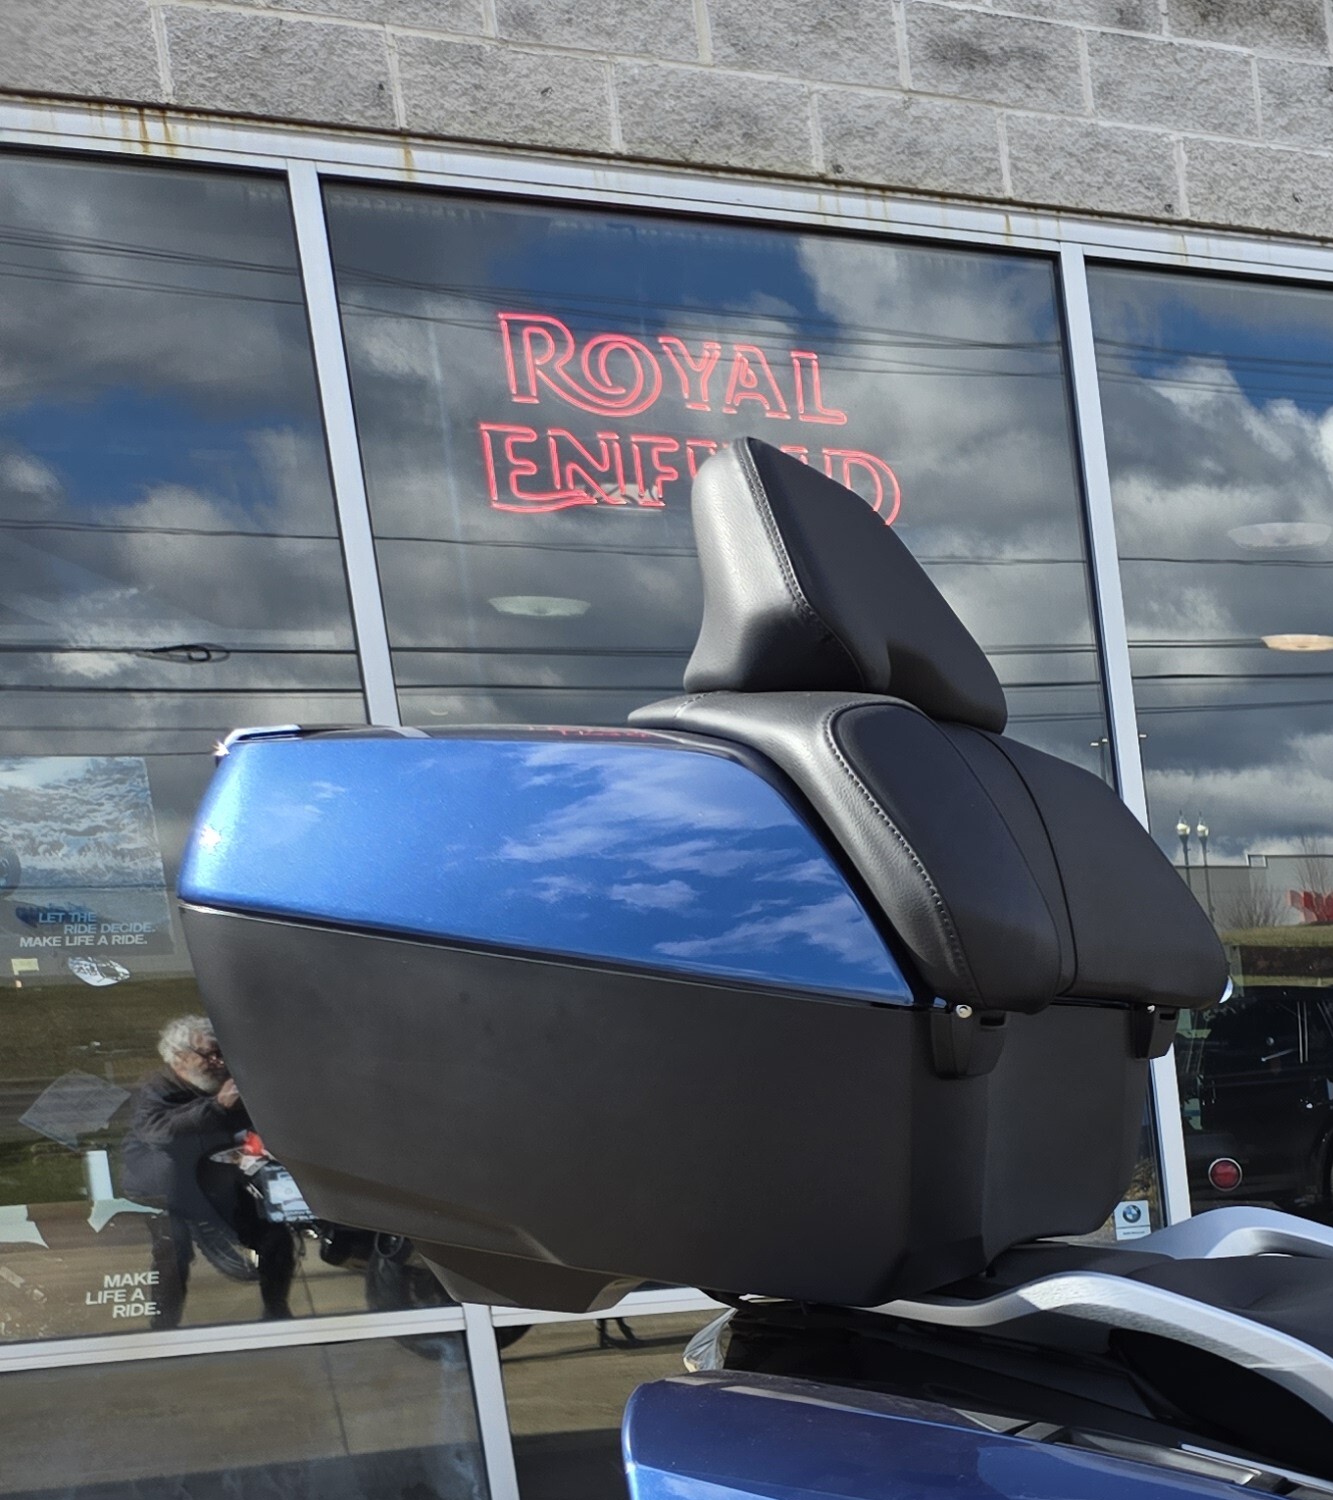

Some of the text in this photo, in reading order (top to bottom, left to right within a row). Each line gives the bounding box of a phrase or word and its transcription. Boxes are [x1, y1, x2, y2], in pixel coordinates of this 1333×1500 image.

[498, 312, 848, 426] ROYAL
[38, 911, 97, 924] LET THE
[63, 922, 156, 935] RIDE DECIDE.
[19, 933, 148, 948] MAKE LIFE A RIDE.
[103, 1270, 160, 1288] MAKE
[85, 1287, 146, 1305] LIFE A
[112, 1301, 162, 1319] RIDE.
